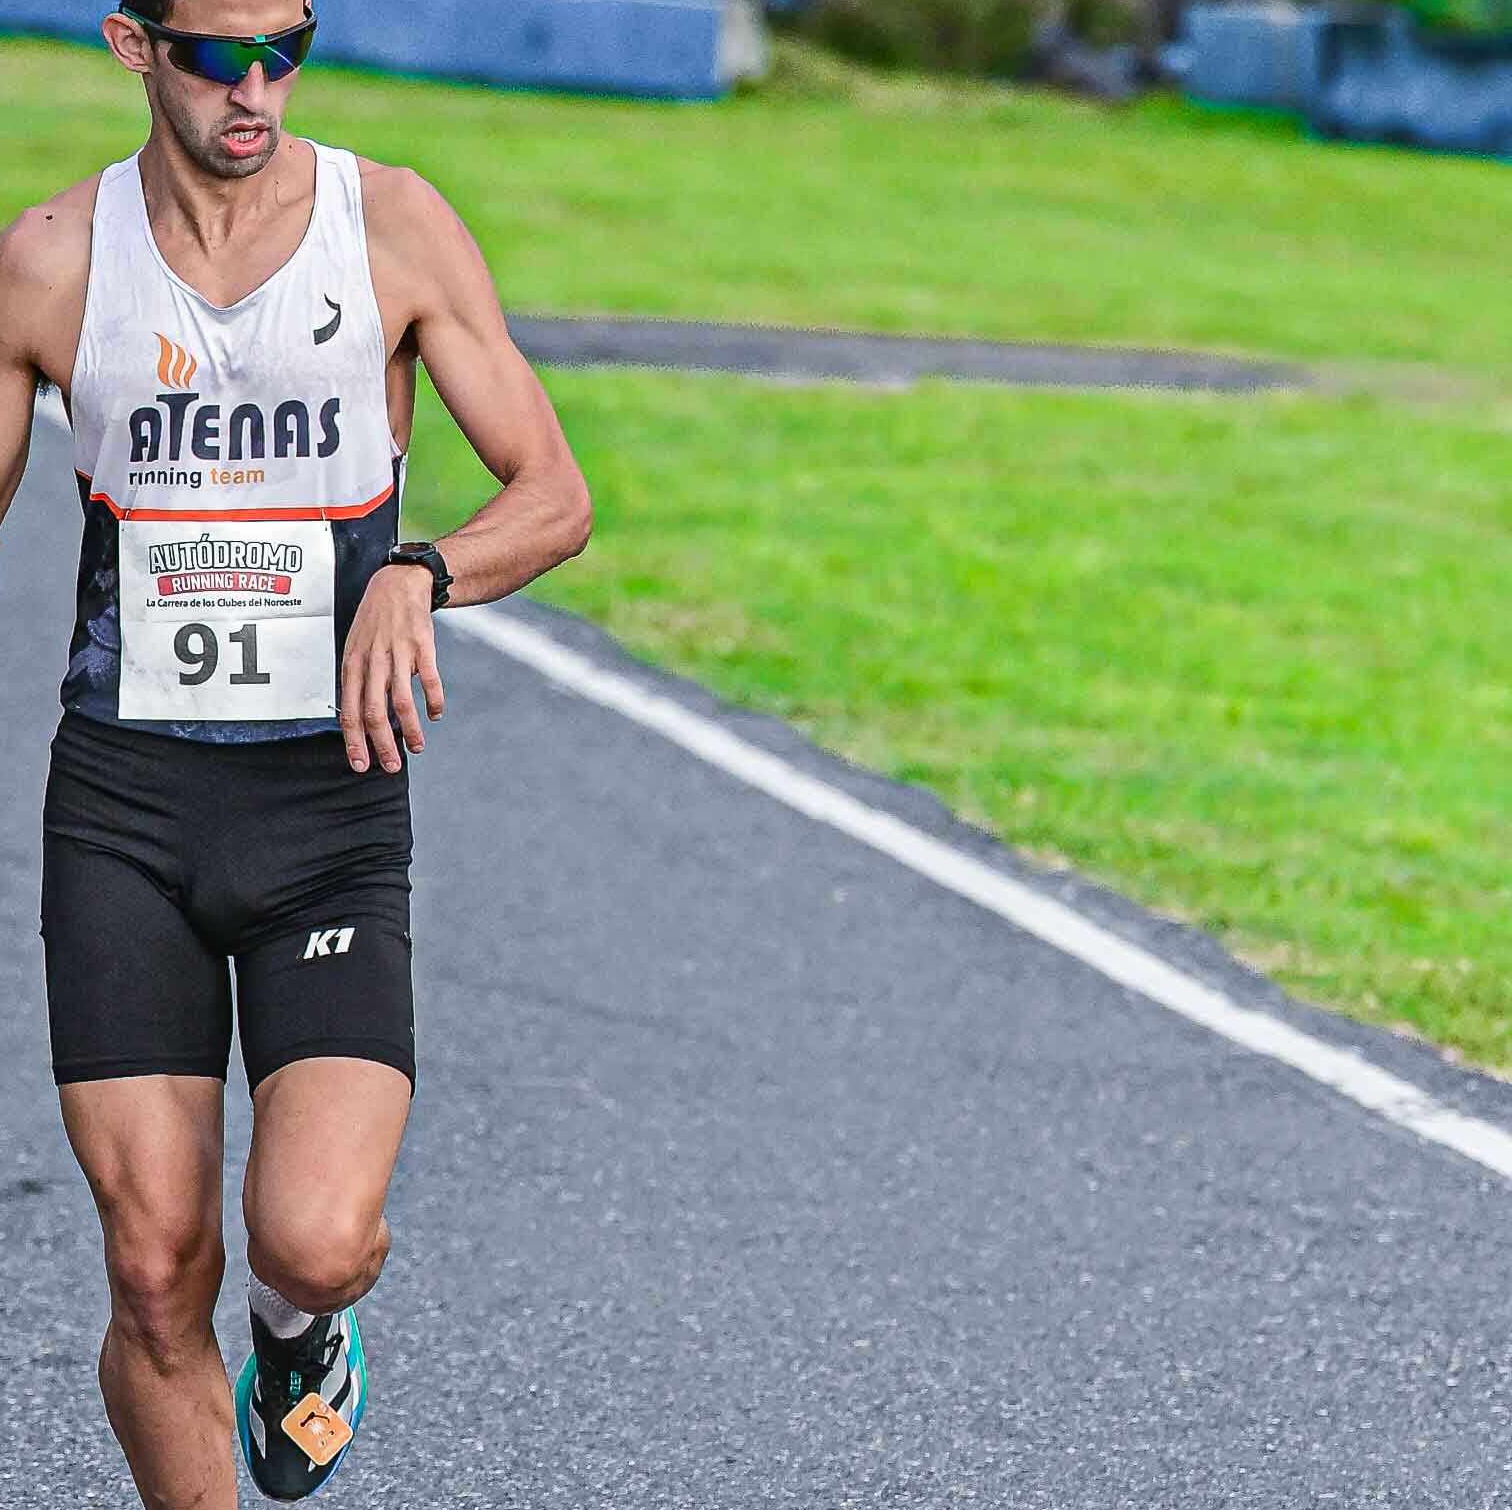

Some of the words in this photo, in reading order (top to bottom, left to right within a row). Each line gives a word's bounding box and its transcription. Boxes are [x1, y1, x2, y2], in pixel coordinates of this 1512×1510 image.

[129, 392, 340, 463] ATENAS
[210, 467, 265, 484] team
[148, 533, 303, 575] AUTÓDROMO
[171, 573, 234, 593] RUNNING
[238, 573, 277, 592] RACE
[146, 598, 156, 608] La
[157, 598, 188, 608] Carrera
[190, 598, 201, 608] de
[202, 598, 216, 608] los
[217, 598, 247, 608] Clubes
[249, 597, 262, 607] del
[264, 597, 302, 607] Noroeste
[173, 622, 271, 686] 91
[303, 927, 356, 960] K1
